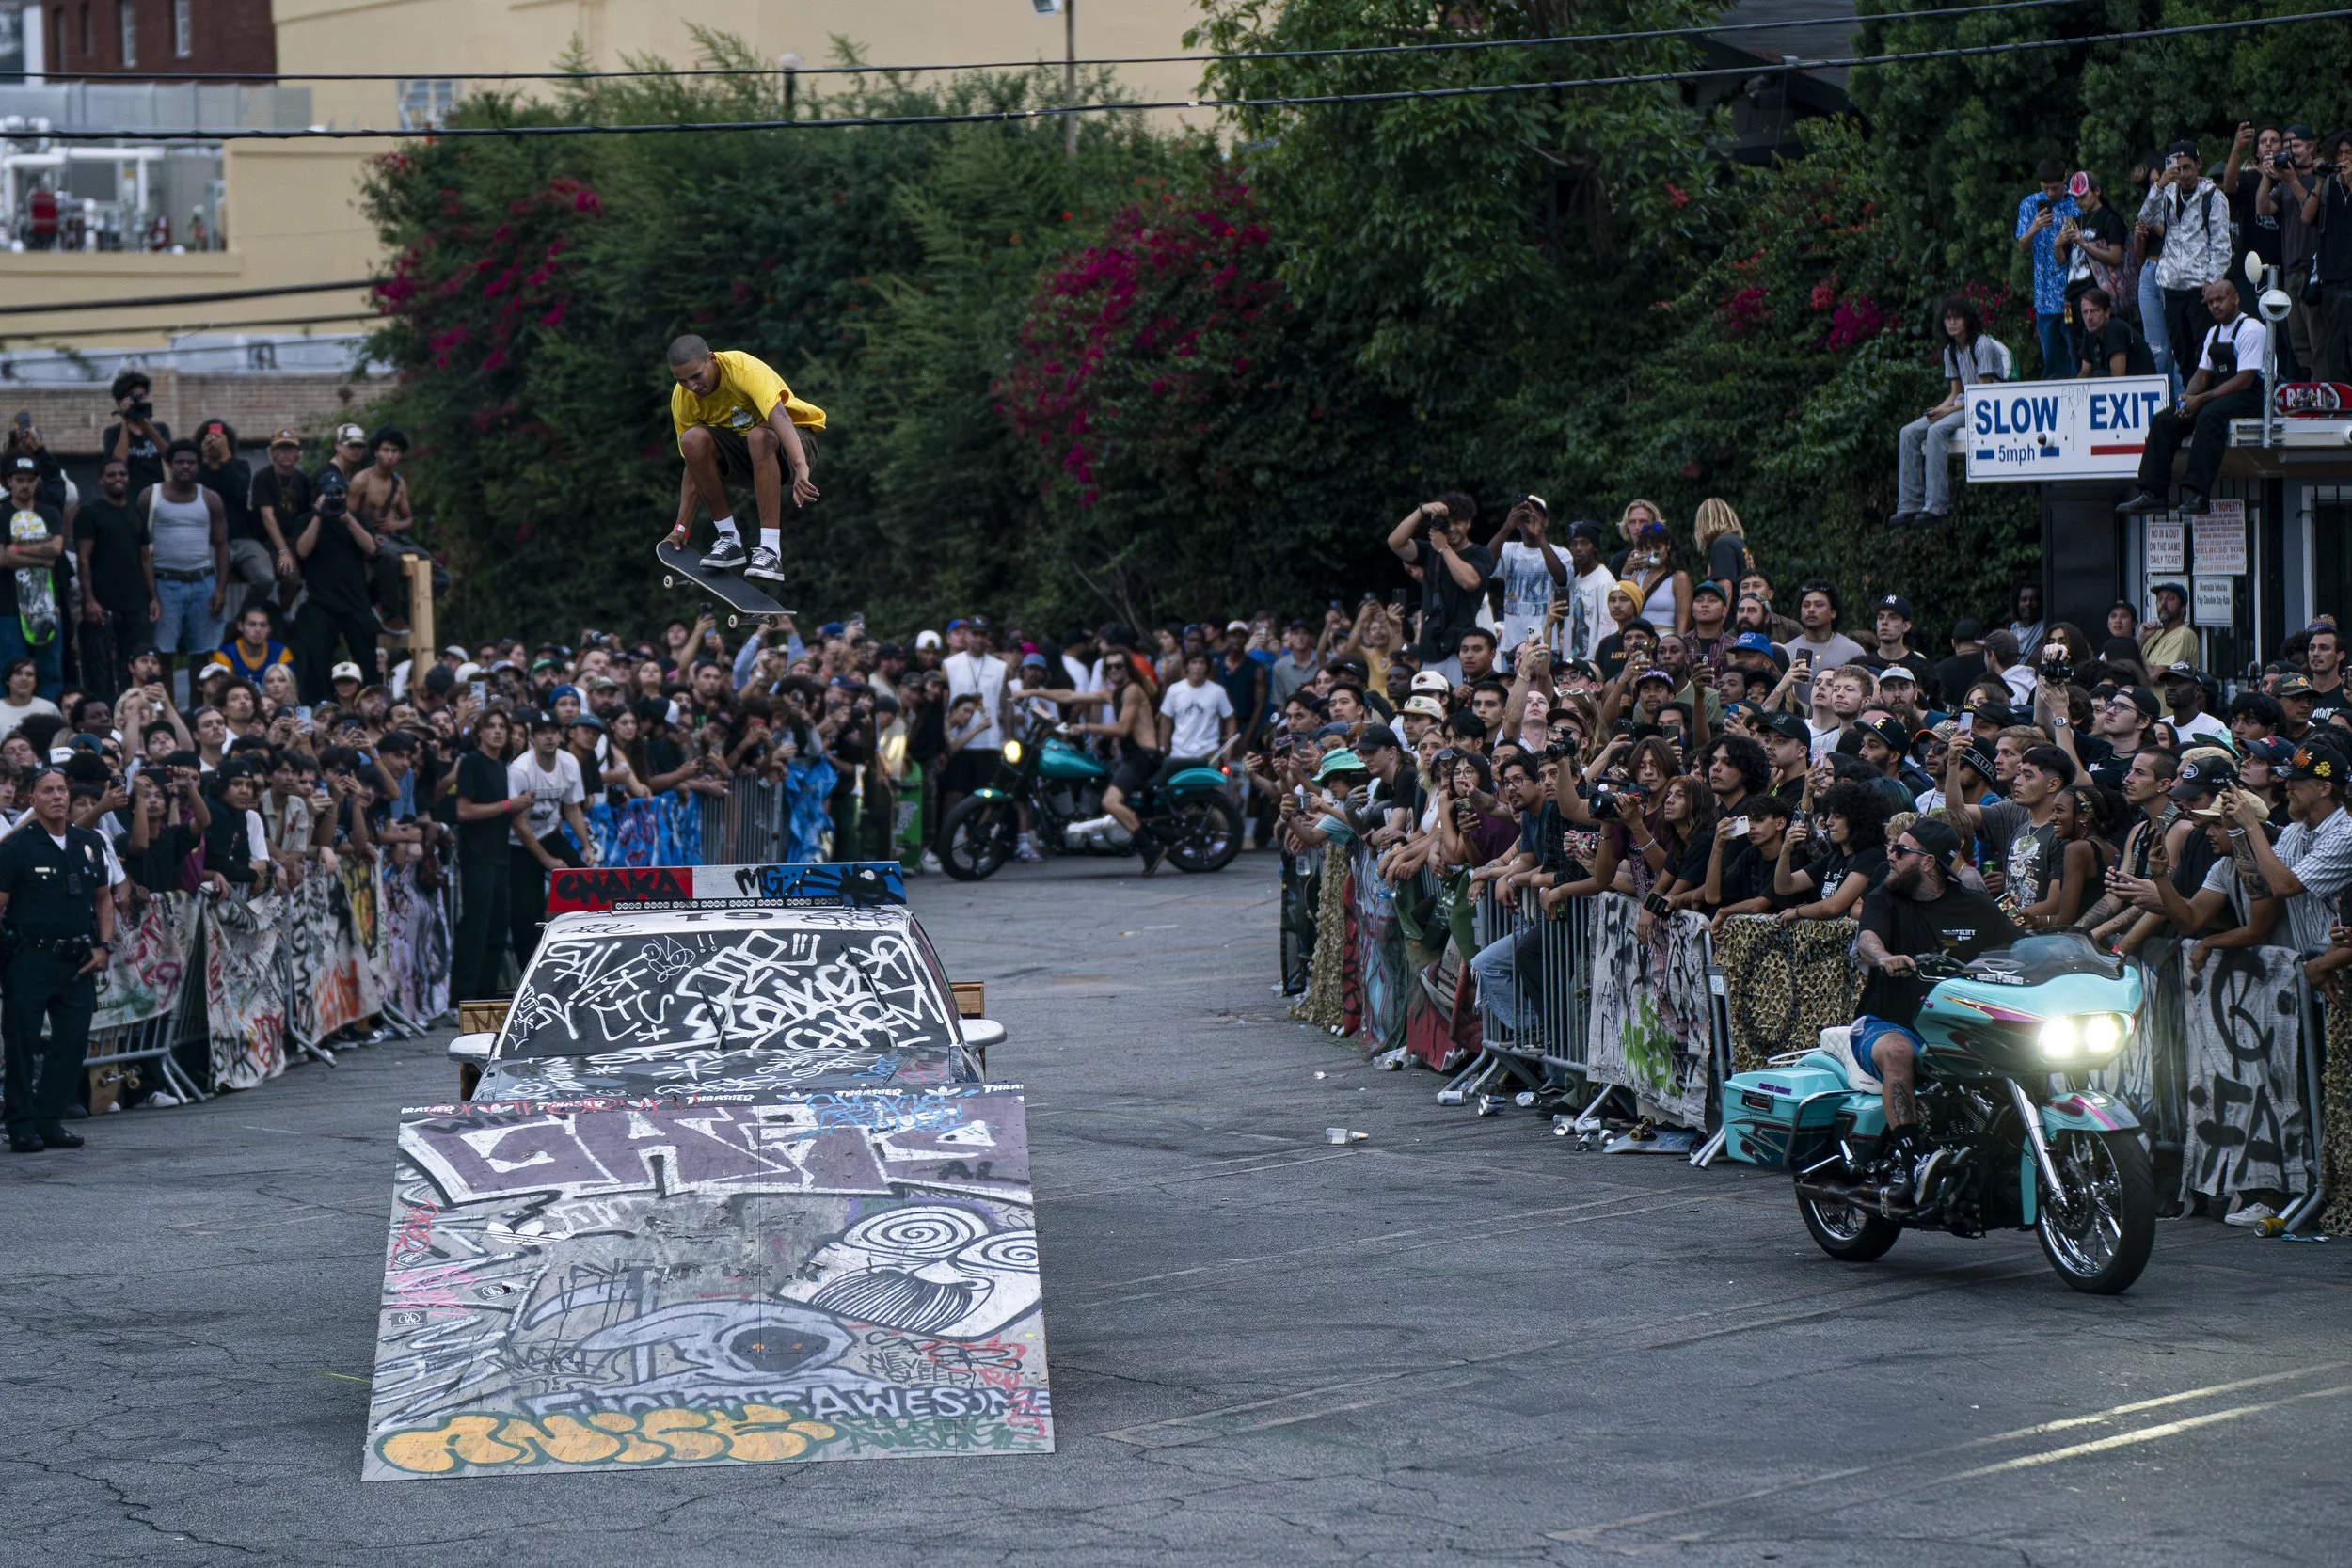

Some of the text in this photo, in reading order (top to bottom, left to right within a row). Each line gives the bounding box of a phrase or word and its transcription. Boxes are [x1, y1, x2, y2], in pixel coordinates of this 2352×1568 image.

[1976, 391, 2160, 436] SLOW EXIT
[1998, 443, 2035, 466] 5mph
[2151, 529, 2159, 538] NO
[2169, 529, 2179, 538] OUT
[2150, 542, 2181, 551] ON THE SAME
[2150, 555, 2181, 564] DAILY TICKET
[556, 868, 685, 905] CHAKA
[685, 1094, 755, 1105] THRASHER
[834, 1087, 904, 1098] THRASHER
[812, 1384, 1052, 1418] AWESOME
